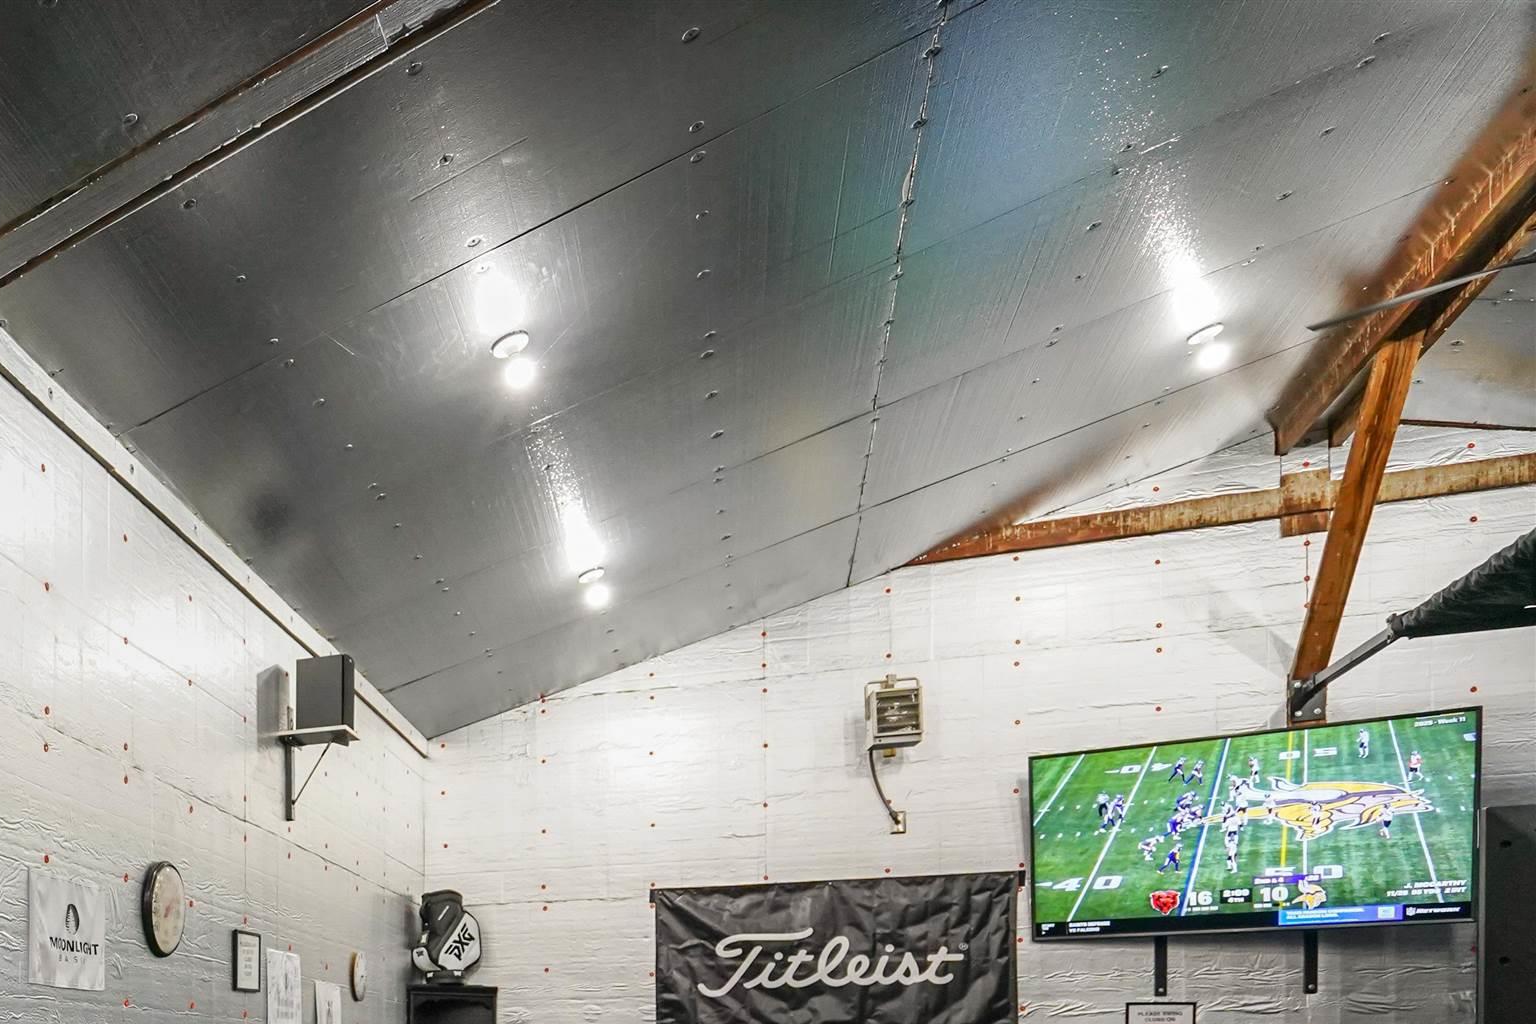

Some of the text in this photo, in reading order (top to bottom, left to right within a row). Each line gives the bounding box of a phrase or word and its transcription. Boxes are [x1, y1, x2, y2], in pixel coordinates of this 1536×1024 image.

[1189, 891, 1213, 906] 16
[1260, 886, 1289, 902] 10
[49, 936, 100, 955] MOONLIGHT
[445, 922, 475, 961] PXG
[697, 927, 964, 998] Titleist
